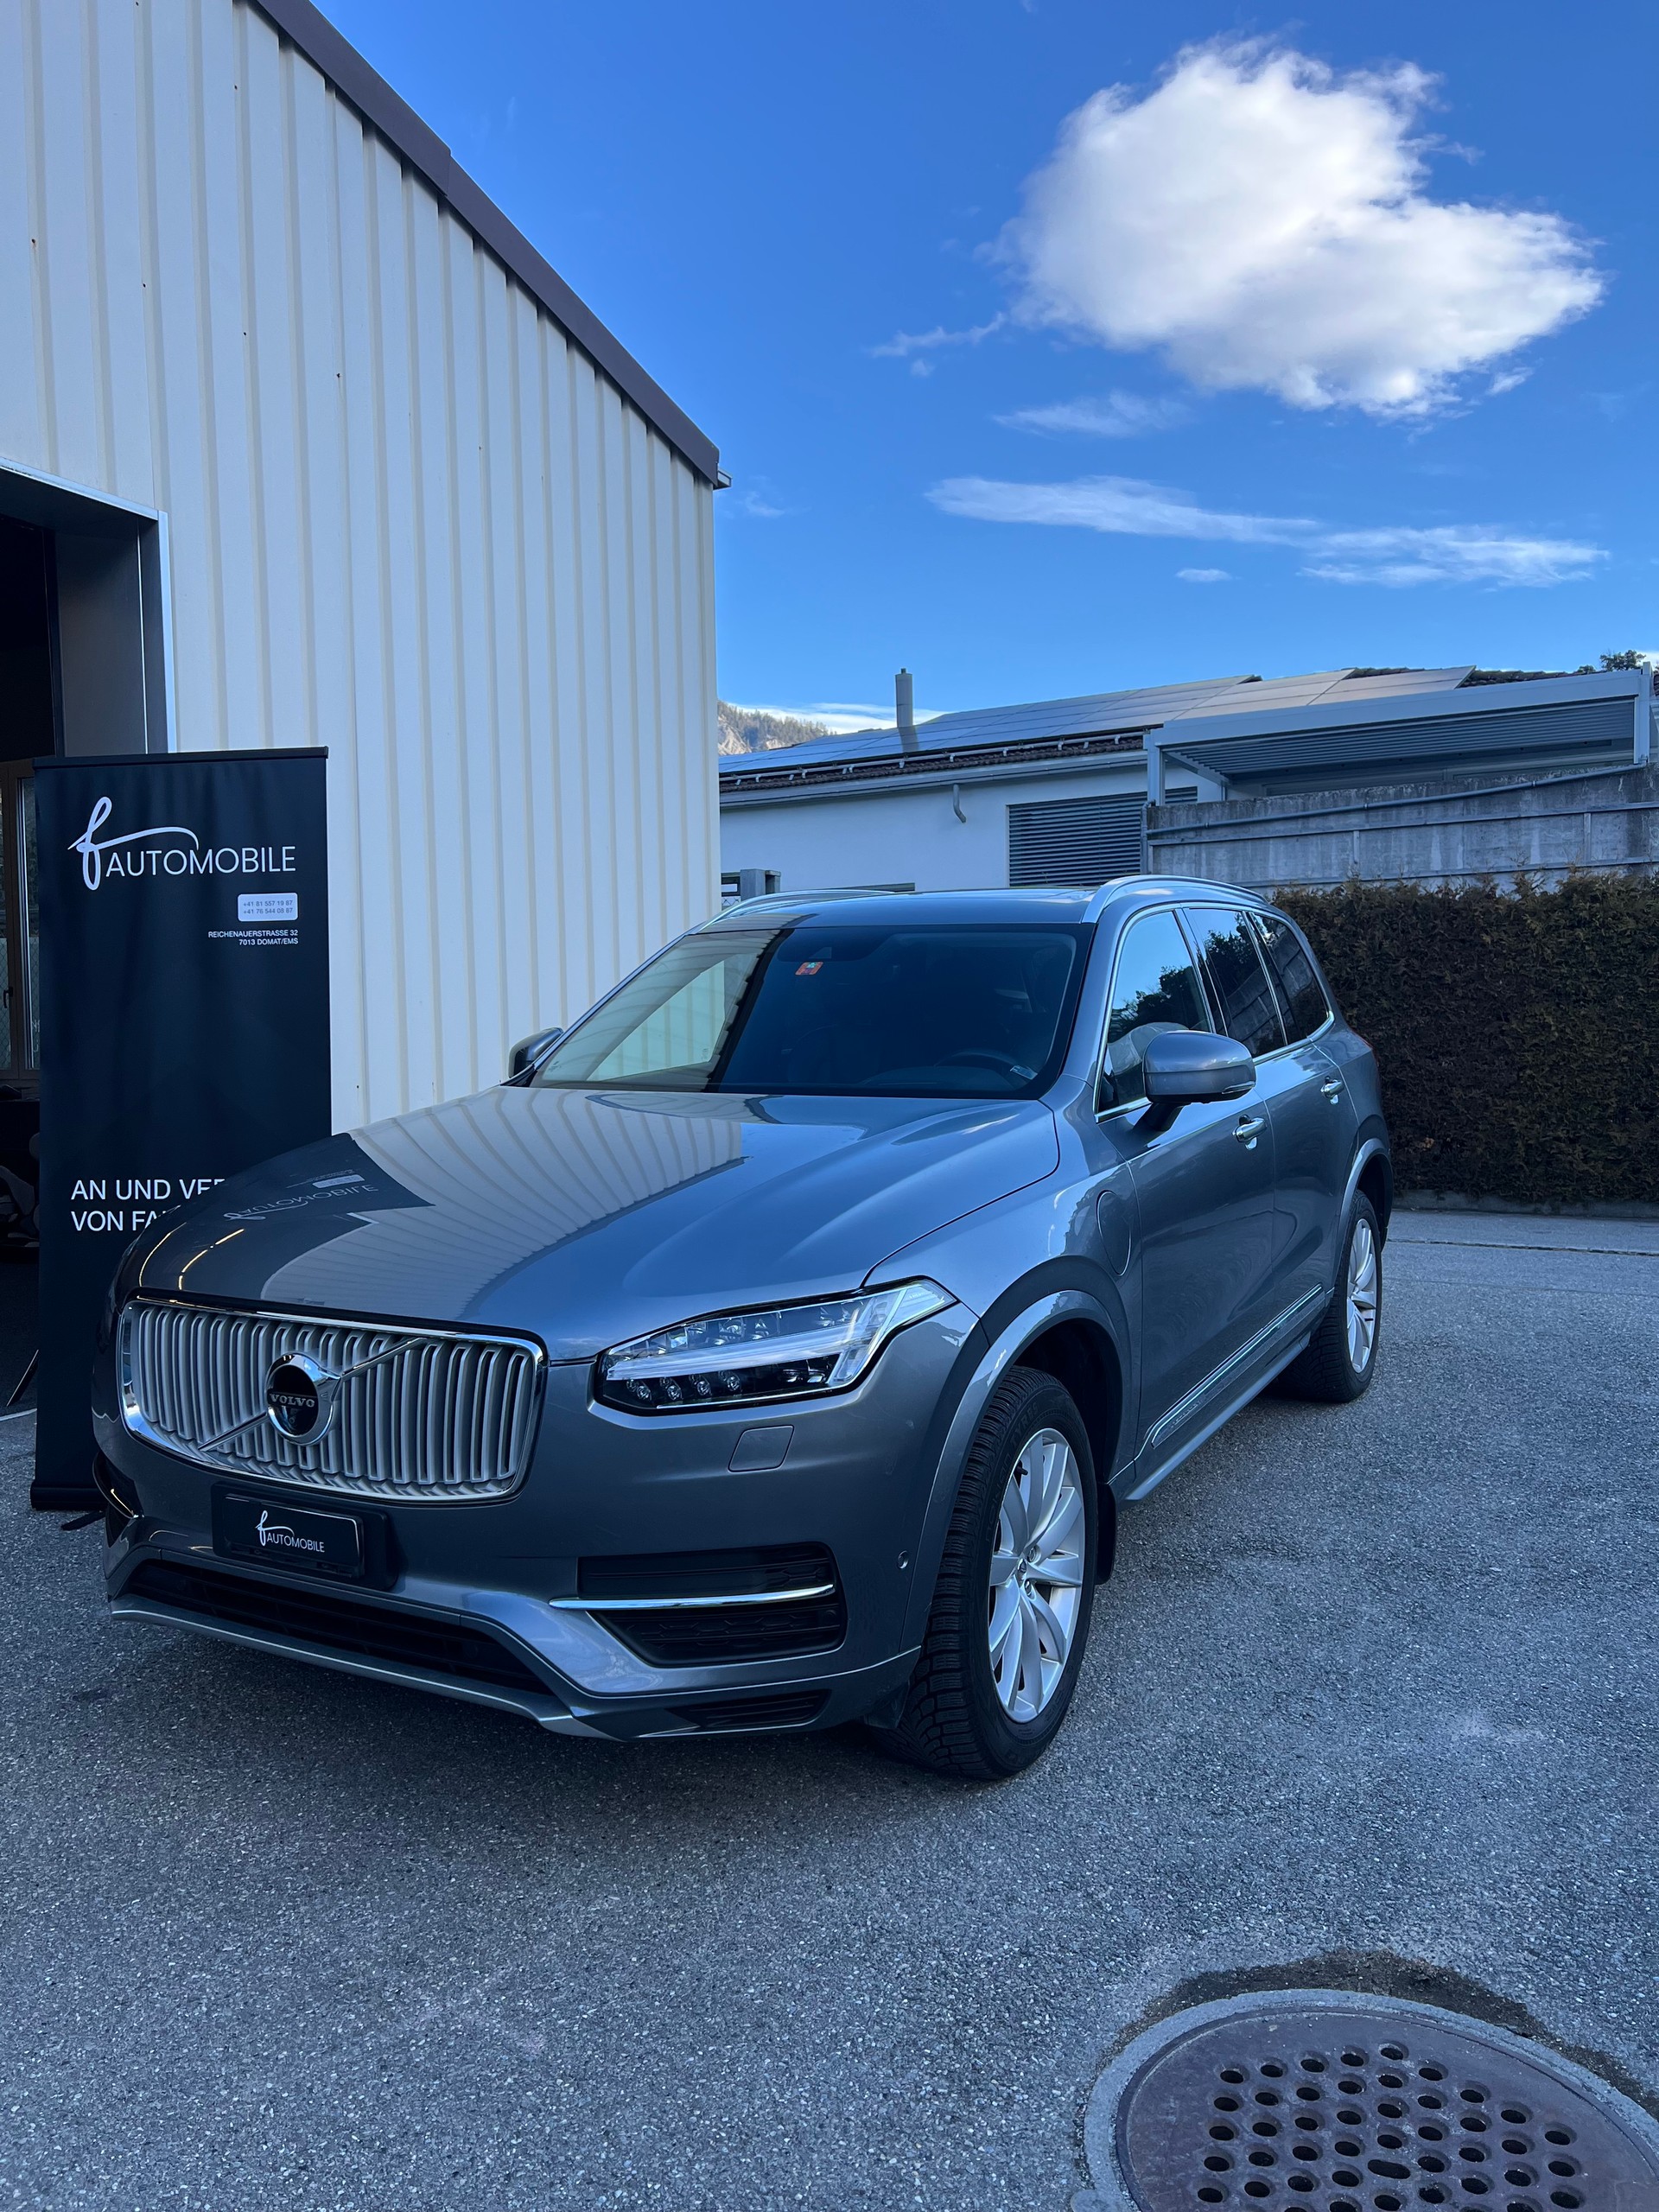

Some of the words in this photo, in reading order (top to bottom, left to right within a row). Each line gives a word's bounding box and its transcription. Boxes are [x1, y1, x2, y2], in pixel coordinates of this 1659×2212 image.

[105, 845, 296, 878] AUTOMOBILE
[71, 1179, 106, 1200] AN
[116, 1179, 171, 1200] UND
[179, 1179, 226, 1199] VE
[71, 1211, 124, 1231] VON
[269, 1393, 315, 1408] VOLVO
[266, 1532, 326, 1553] AUTOMOBILE
